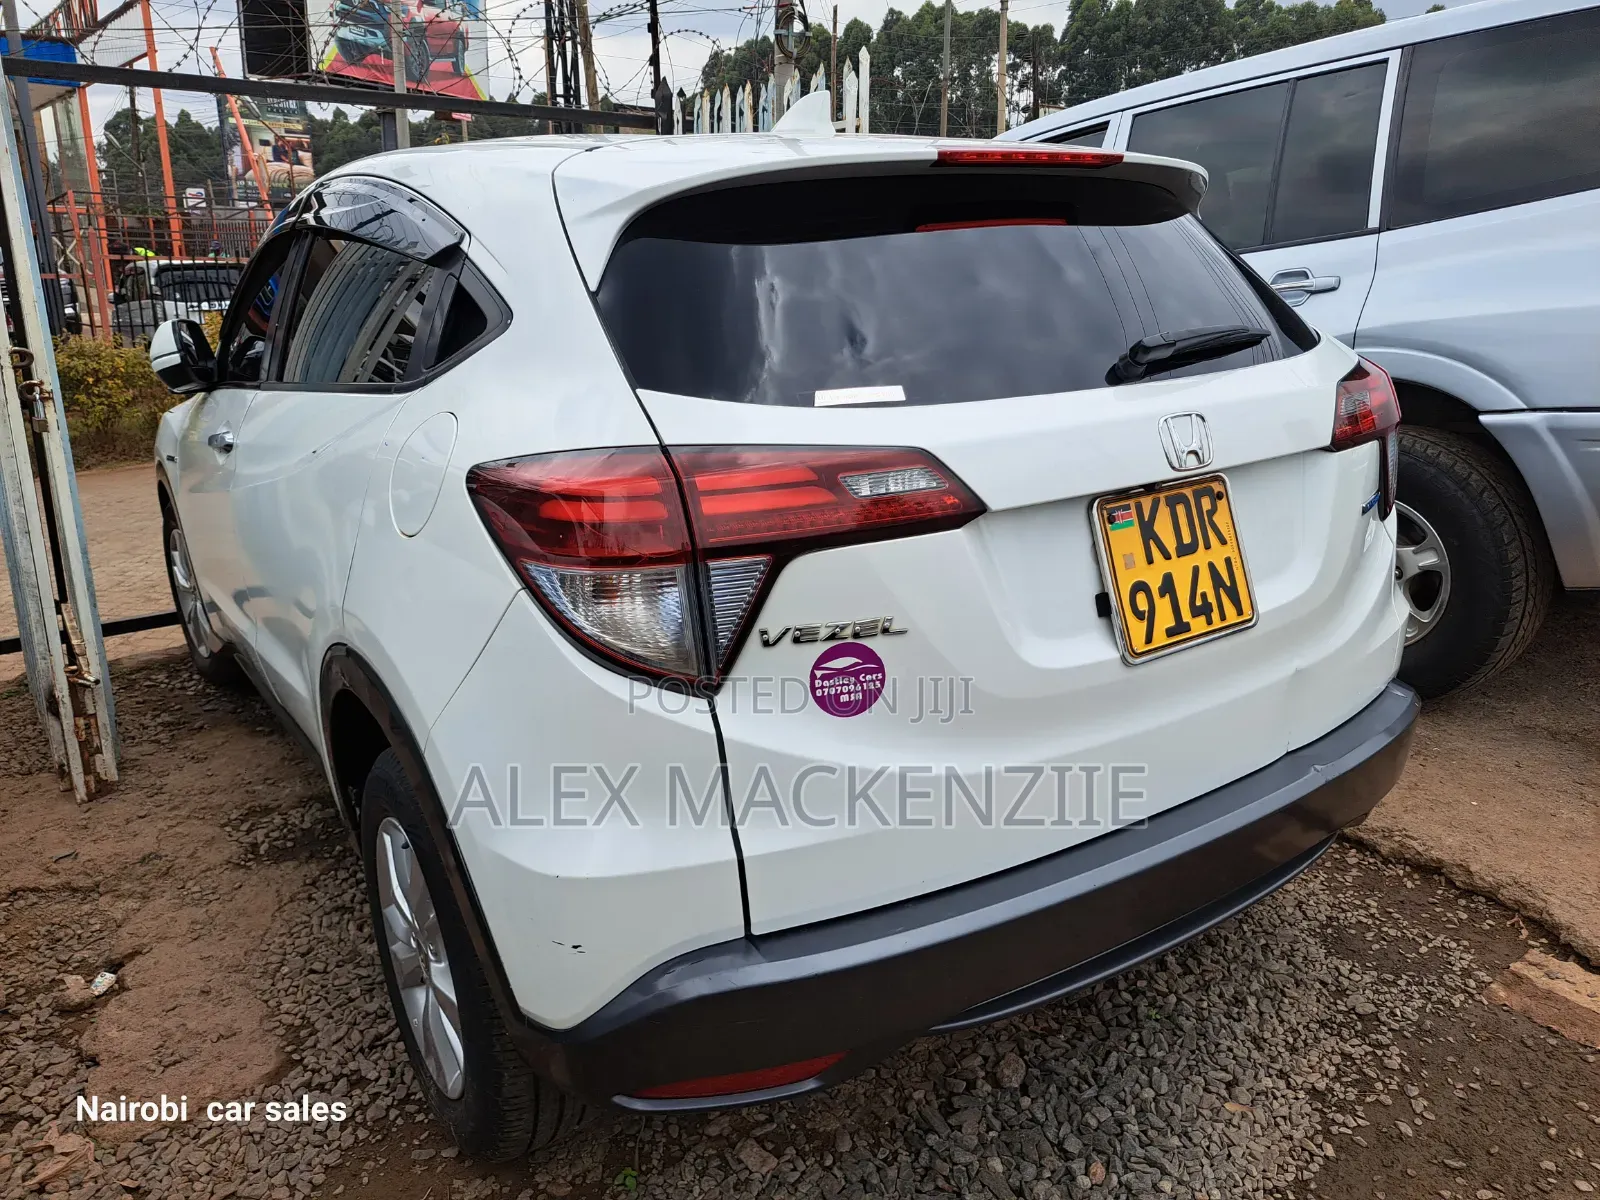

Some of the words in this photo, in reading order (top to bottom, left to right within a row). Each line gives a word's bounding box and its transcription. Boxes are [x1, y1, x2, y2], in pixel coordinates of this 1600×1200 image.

[1134, 486, 1227, 565] KDR
[1128, 556, 1244, 645] 914N
[758, 616, 909, 648] VEZEL
[859, 673, 883, 681] Cars
[840, 692, 863, 703] MSA
